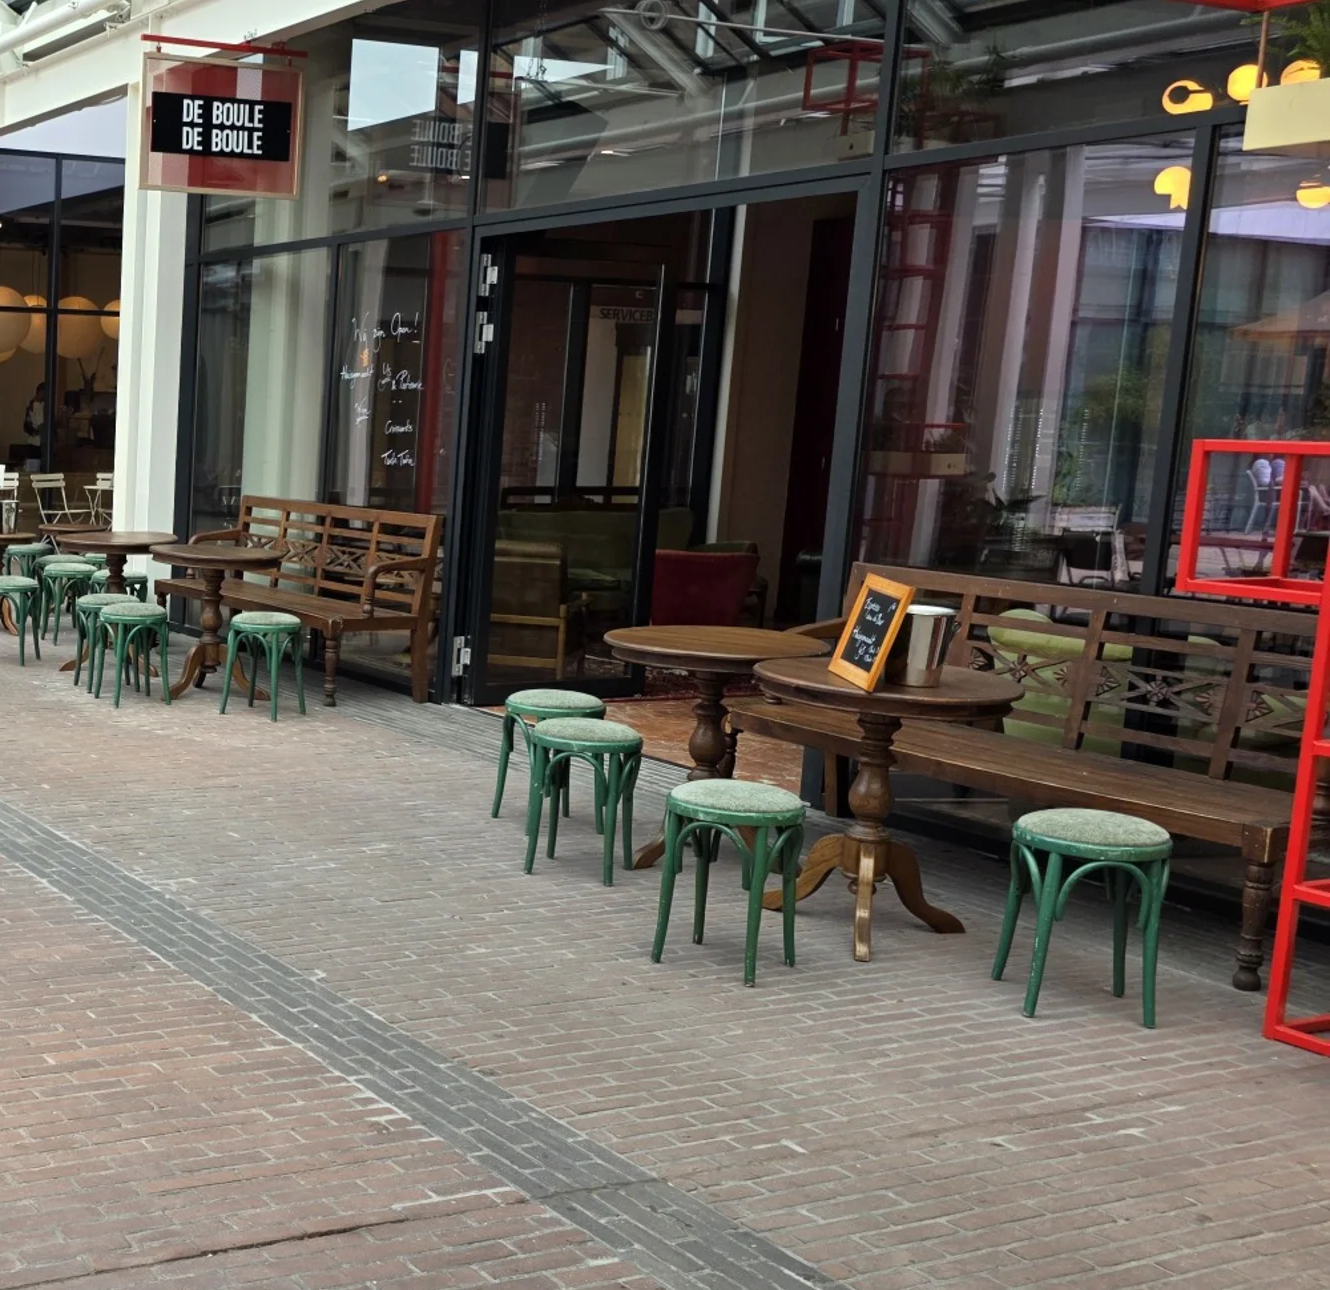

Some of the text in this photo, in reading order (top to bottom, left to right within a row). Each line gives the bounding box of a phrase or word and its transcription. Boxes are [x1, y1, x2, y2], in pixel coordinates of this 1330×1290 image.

[182, 98, 264, 129] DE BOULE
[181, 126, 263, 155] DE BOULE
